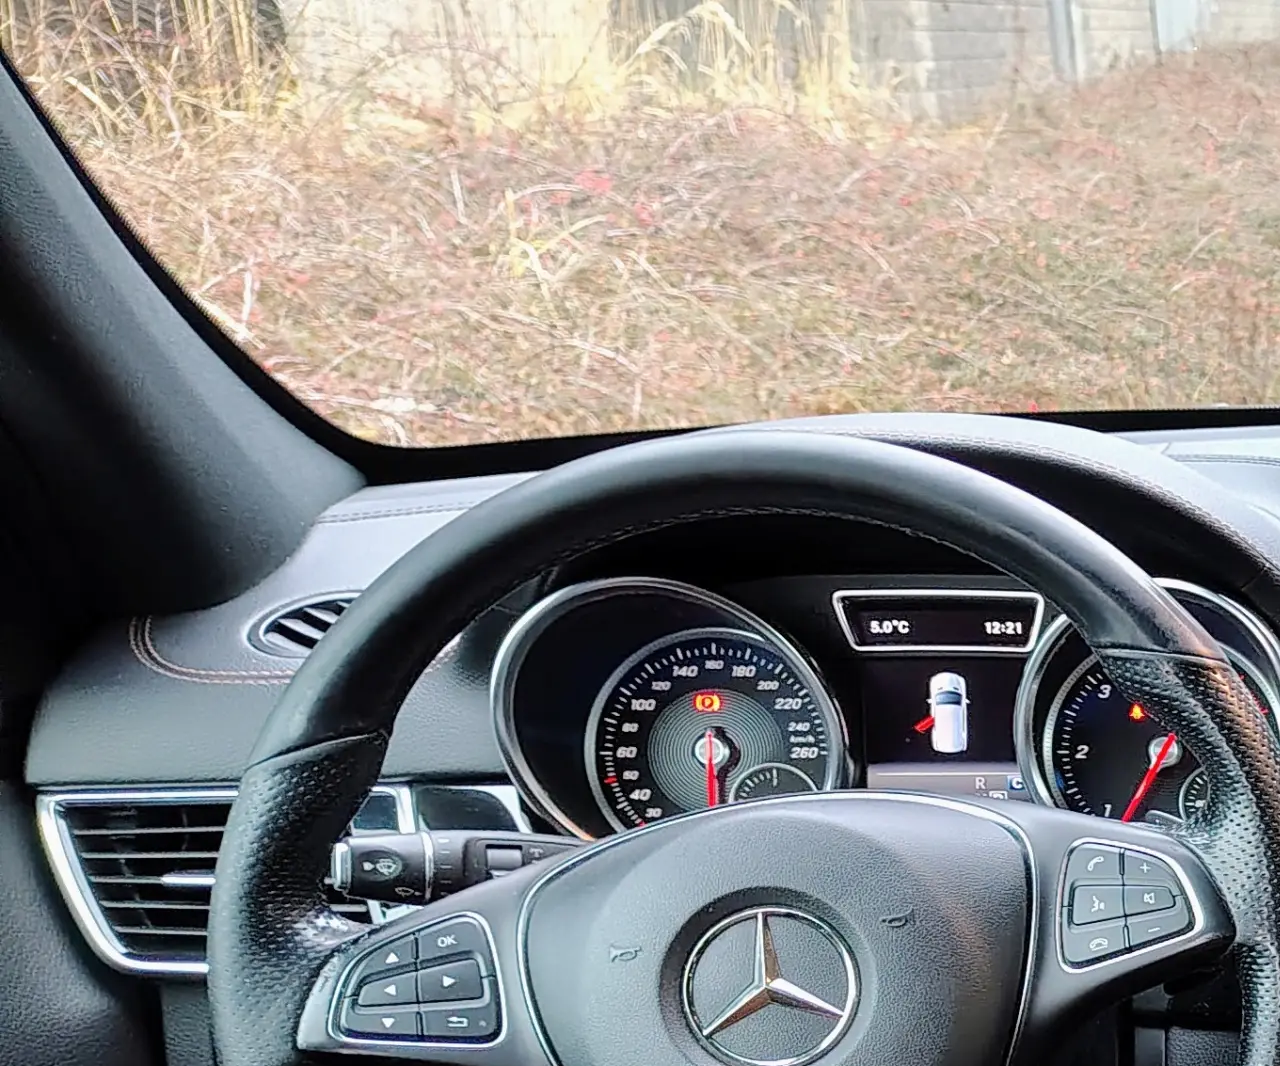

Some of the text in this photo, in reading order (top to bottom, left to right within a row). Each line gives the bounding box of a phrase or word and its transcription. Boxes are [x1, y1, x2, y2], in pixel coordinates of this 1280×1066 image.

[870, 620, 910, 634] 5.0°C
[985, 621, 1023, 634] 12:21
[672, 666, 698, 677] 140
[731, 666, 756, 677] 180
[651, 681, 671, 691] 120
[756, 681, 779, 691] 200
[1098, 684, 1112, 699] 3
[631, 699, 656, 711] 100
[774, 700, 802, 710] 220
[788, 722, 811, 731] 240
[616, 747, 637, 758] 60
[789, 747, 819, 759] 260
[1075, 745, 1090, 759] 2
[975, 777, 986, 790] R
[1011, 777, 1023, 789] C
[629, 789, 651, 801] 40
[1103, 804, 1112, 817] 1
[437, 934, 459, 948] OK
